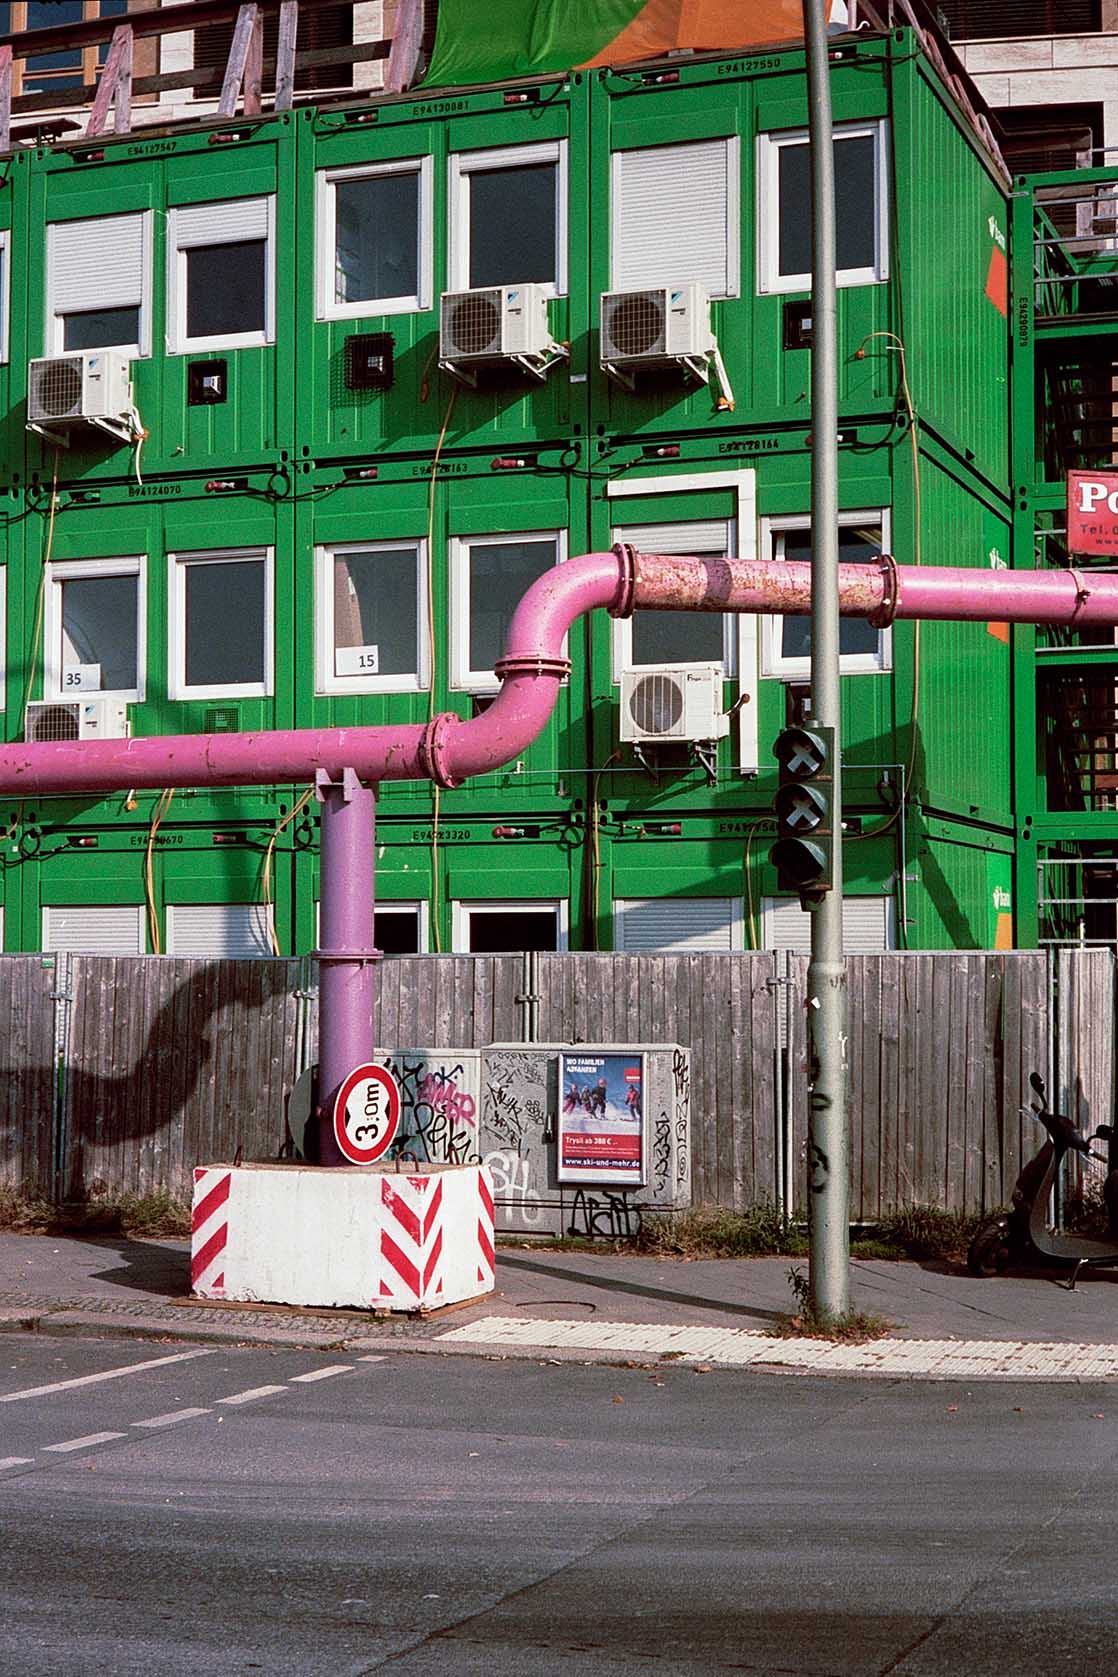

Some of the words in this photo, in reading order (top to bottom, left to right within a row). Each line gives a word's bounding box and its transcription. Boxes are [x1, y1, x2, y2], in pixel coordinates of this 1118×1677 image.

[717, 58, 781, 75] E94127550
[359, 654, 375, 668] 15
[66, 673, 81, 685] 35
[565, 1159, 640, 1168] www.ski-und-mehr.de
